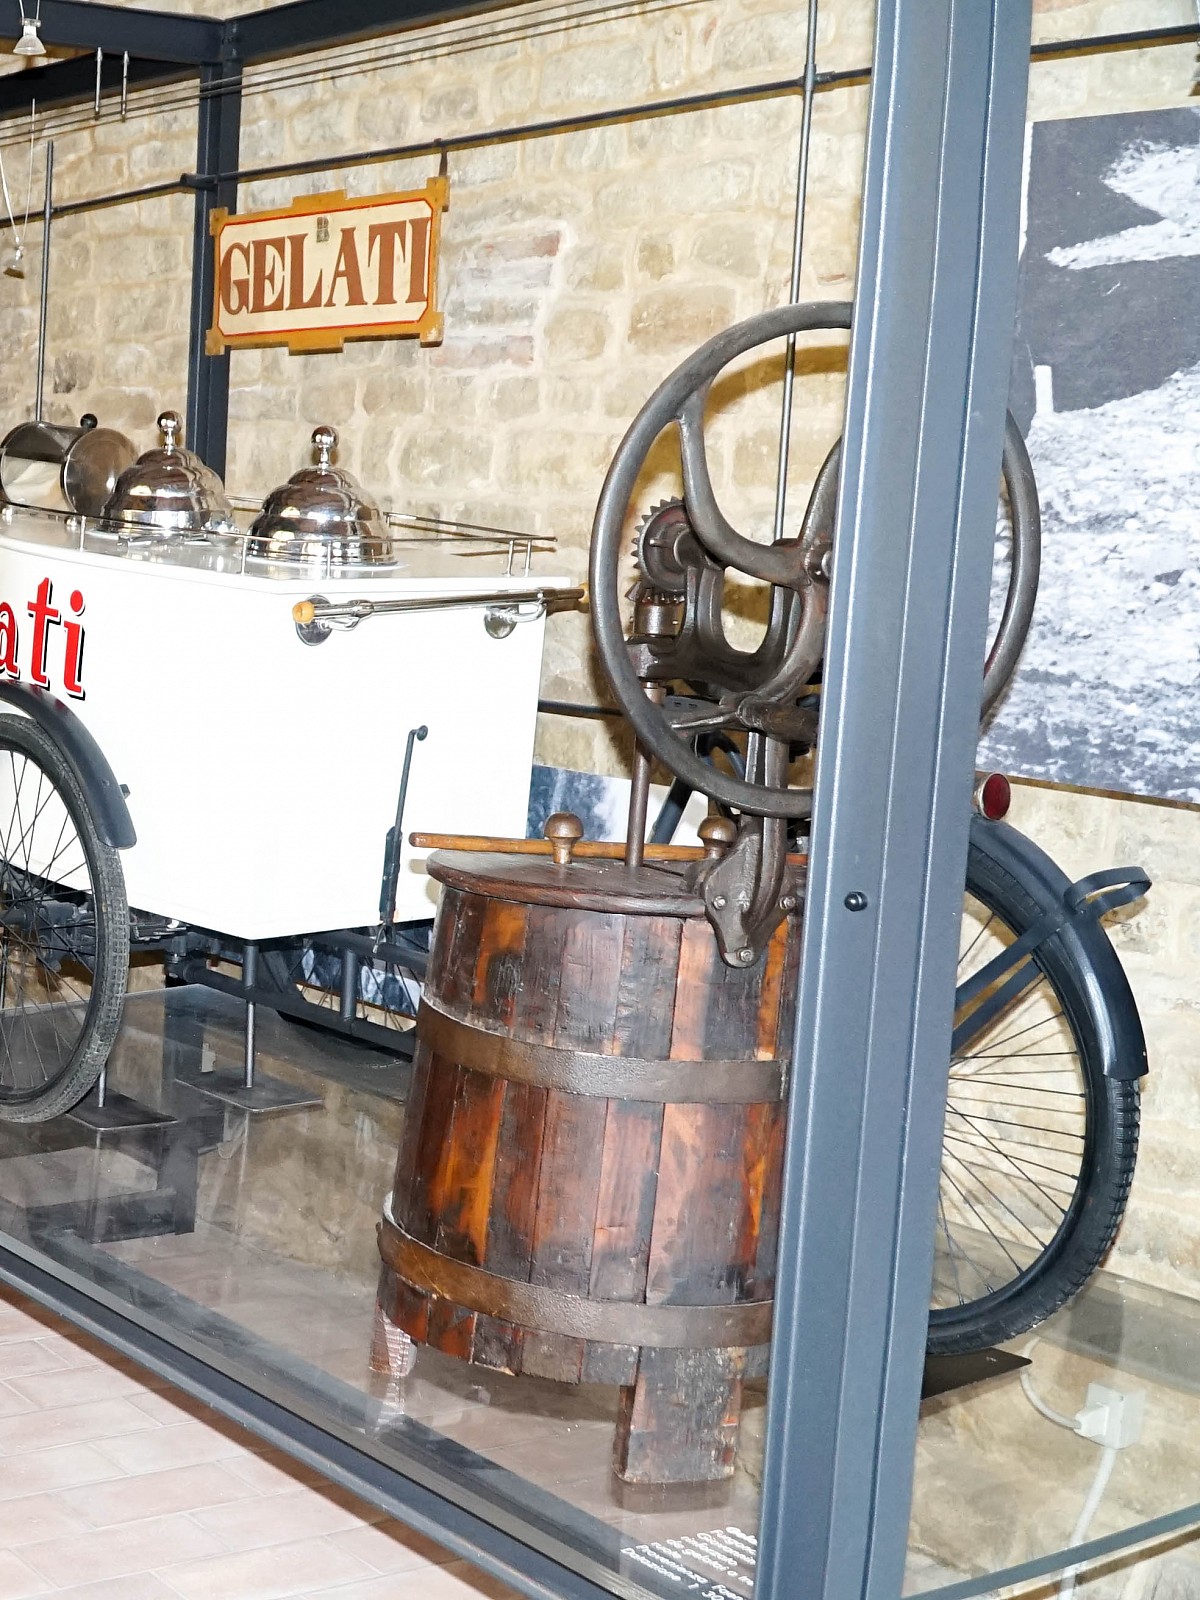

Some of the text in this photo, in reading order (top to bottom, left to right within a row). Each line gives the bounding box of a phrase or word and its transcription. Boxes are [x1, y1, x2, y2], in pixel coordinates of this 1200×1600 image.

[220, 217, 432, 316] GELATI
[621, 1548, 681, 1581] Datazione
[636, 1545, 708, 1584] Provenienza
